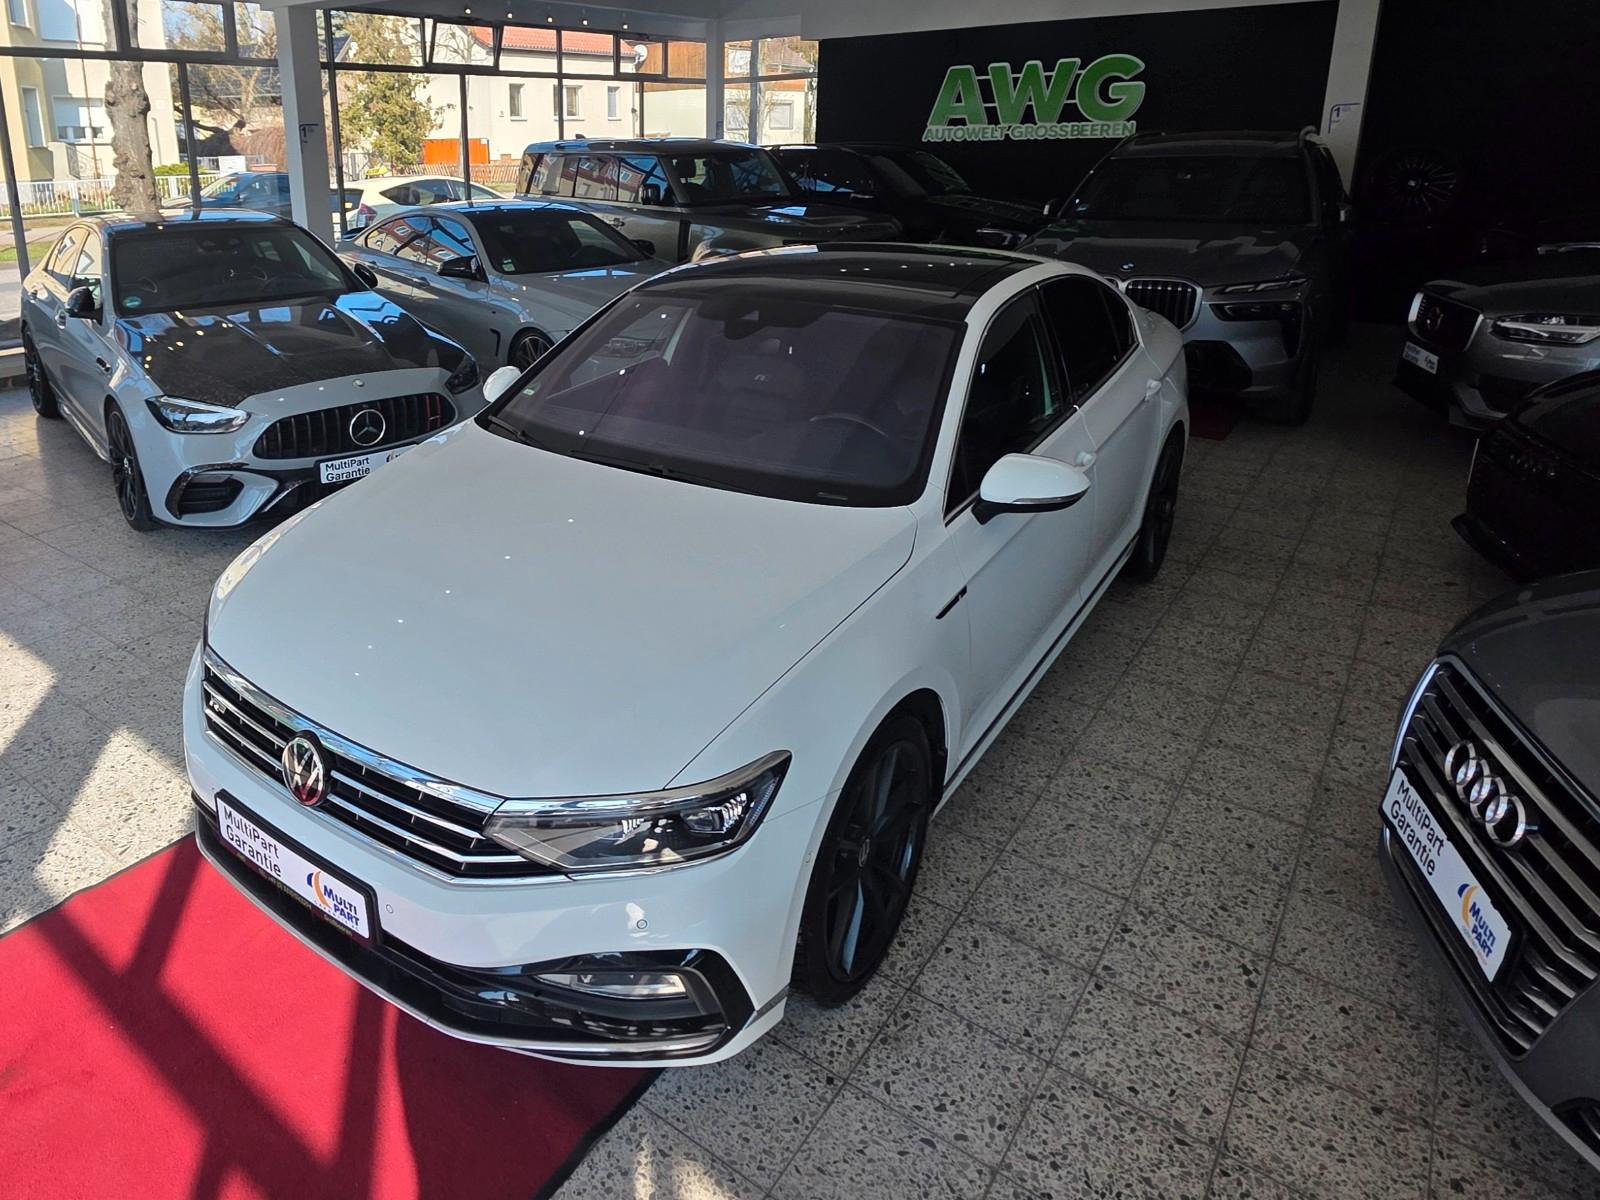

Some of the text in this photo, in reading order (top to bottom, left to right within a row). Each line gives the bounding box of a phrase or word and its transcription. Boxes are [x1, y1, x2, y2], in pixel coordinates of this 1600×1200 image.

[928, 54, 1145, 125] AWG
[325, 457, 370, 472] MultiPart
[326, 467, 370, 481] Garantie
[224, 805, 279, 859] MultiPart
[1390, 800, 1436, 876] Garantie
[1397, 779, 1445, 856] MultiPart
[226, 825, 281, 877] Garantie
[323, 884, 357, 916] MULTI
[334, 903, 360, 926] PART
[1468, 901, 1496, 947] MULTI
[1471, 926, 1493, 958] PART
